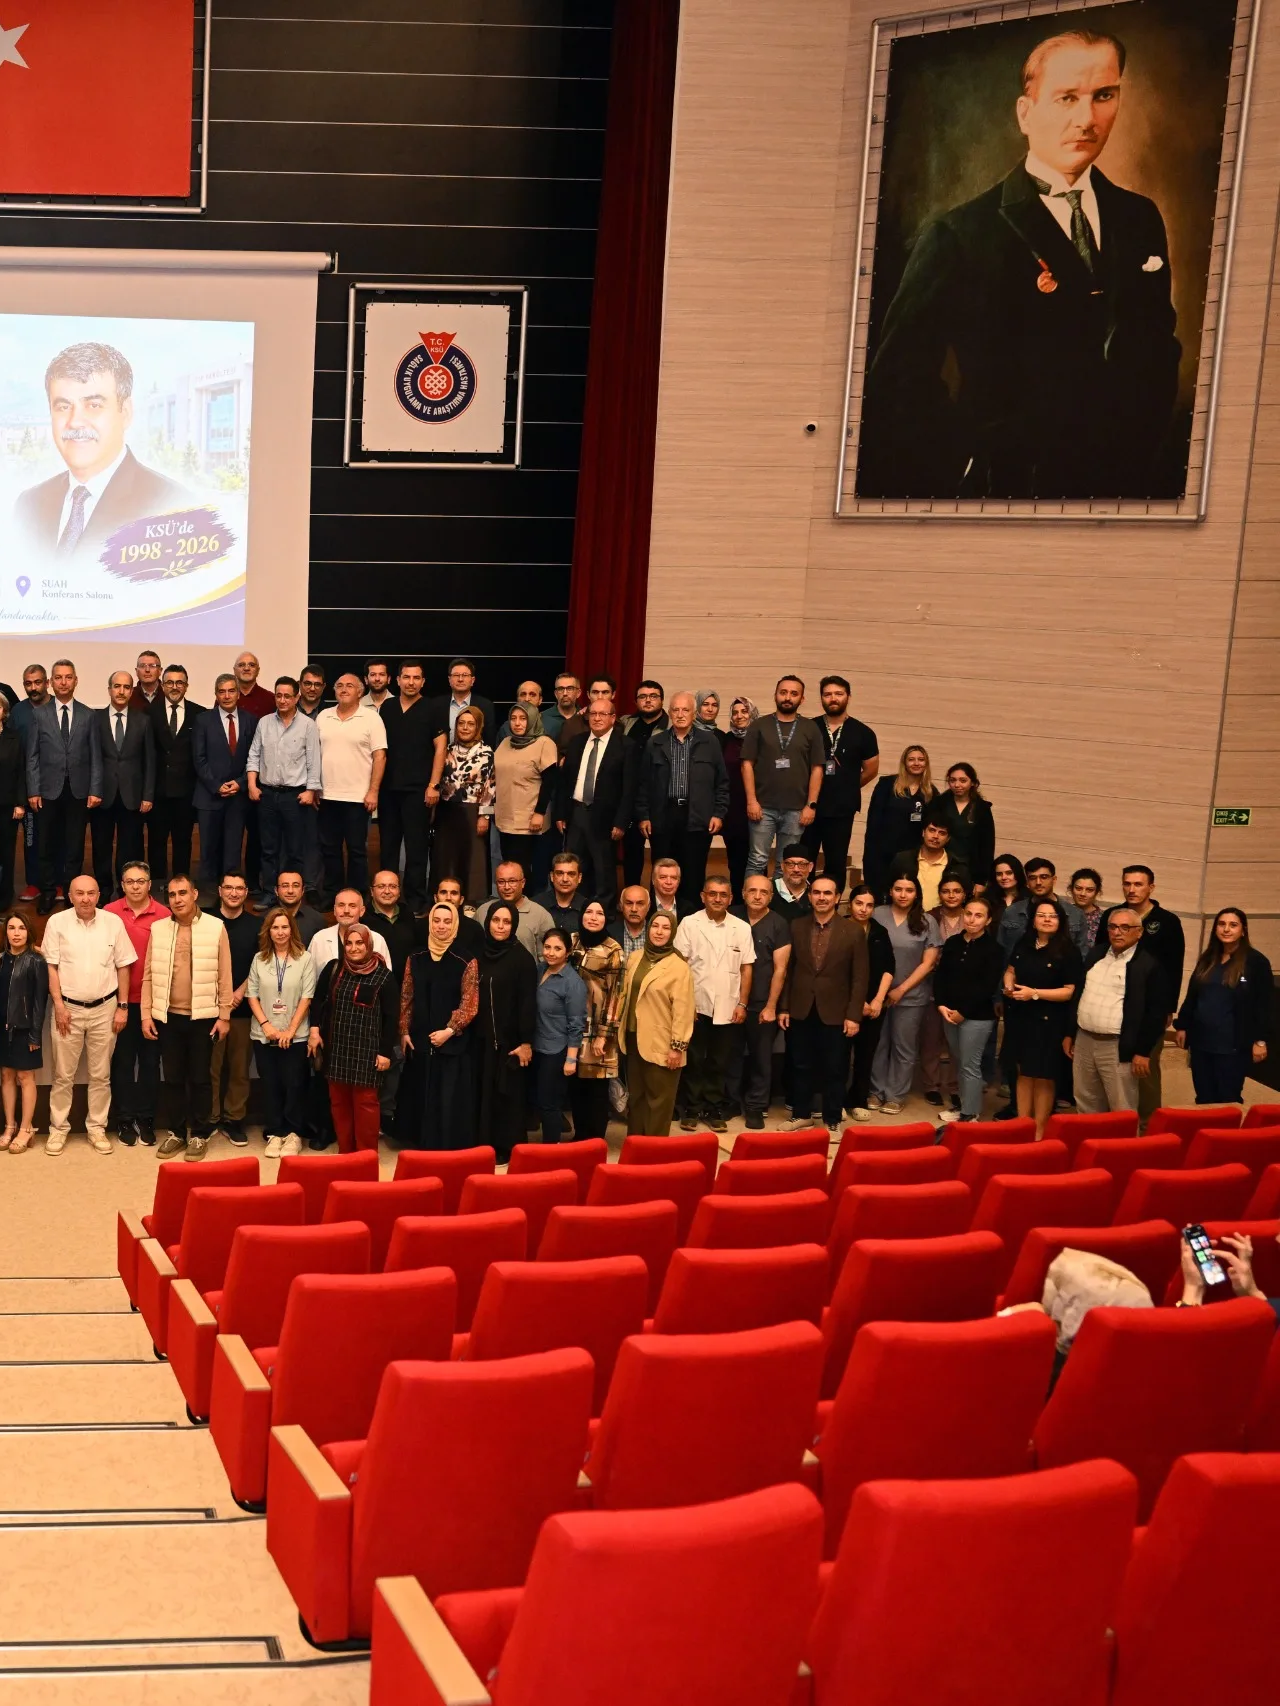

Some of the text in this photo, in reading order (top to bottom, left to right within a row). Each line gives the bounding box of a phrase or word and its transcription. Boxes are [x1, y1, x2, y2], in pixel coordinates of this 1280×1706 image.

[430, 338, 445, 346] T.C.
[403, 354, 469, 416] SAĞLIK UYGULAMA VE ARAŞTIRMA HASTANESİ
[118, 541, 162, 564] 1998
[175, 533, 220, 557] 2026
[41, 589, 114, 600] Konferans Salonu
